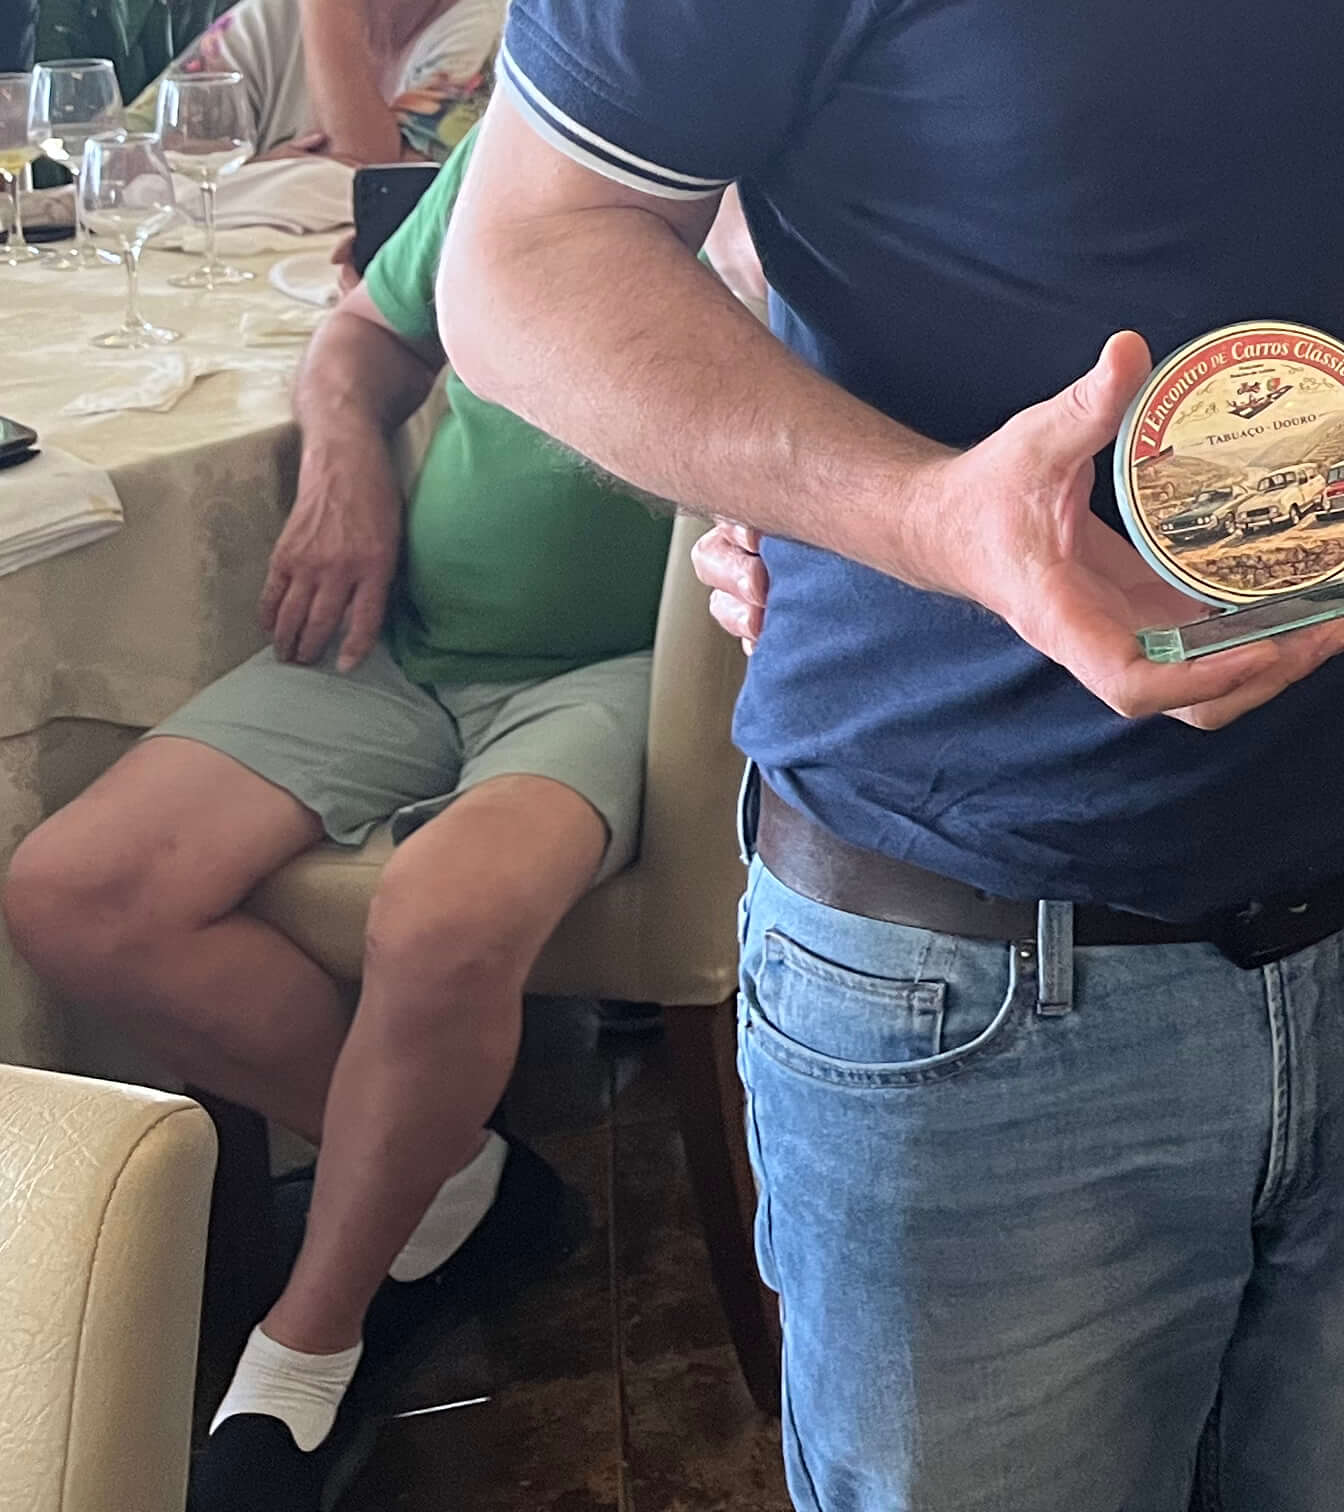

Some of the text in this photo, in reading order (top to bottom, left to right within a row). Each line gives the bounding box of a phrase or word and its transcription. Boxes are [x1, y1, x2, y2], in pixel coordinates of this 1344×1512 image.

[1144, 360, 1209, 432] Encontro
[1210, 351, 1228, 368] DE
[1231, 340, 1289, 360] Carros
[1206, 426, 1265, 445] TABUAÇO
[1273, 414, 1317, 431] DOURO
